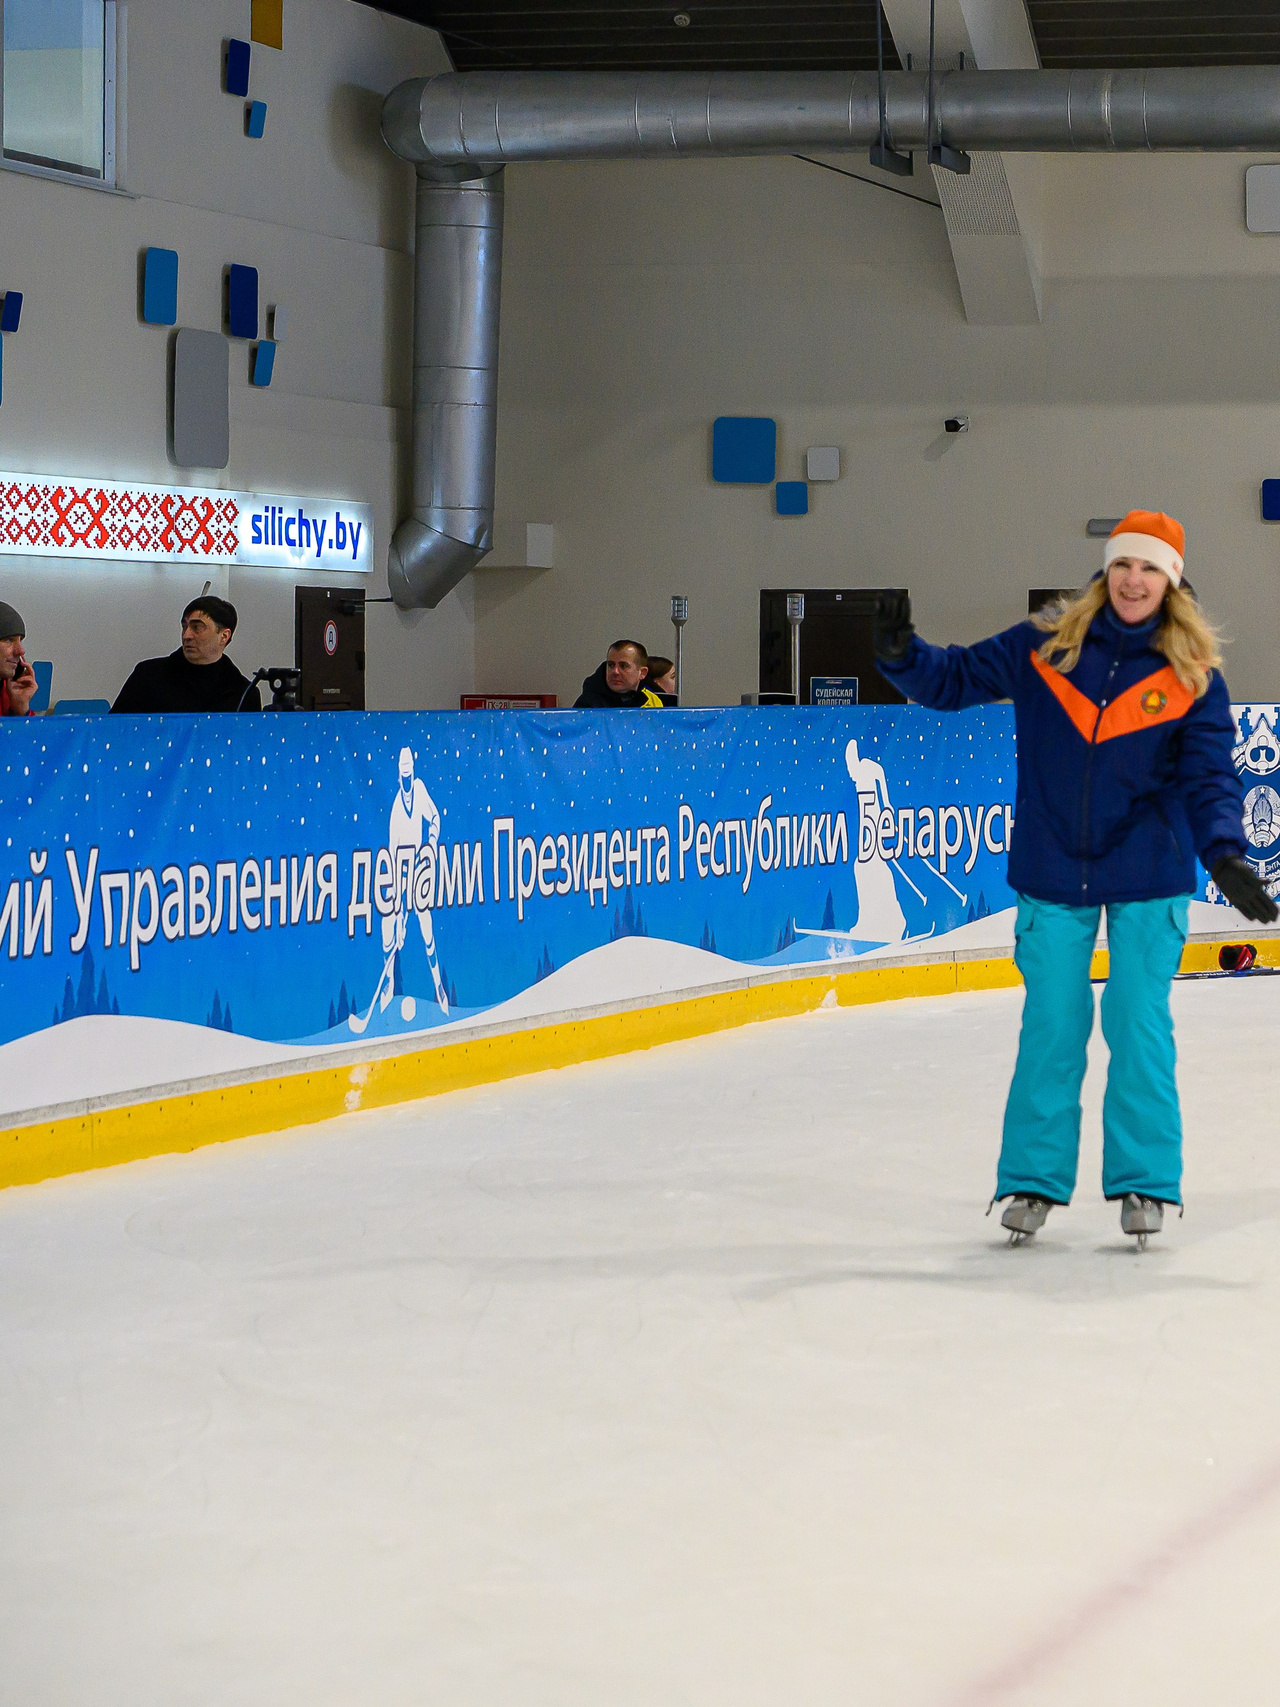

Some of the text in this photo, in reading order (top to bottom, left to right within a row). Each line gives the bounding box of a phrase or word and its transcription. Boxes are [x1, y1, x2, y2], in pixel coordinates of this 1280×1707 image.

[251, 505, 362, 560] silichy.by
[815, 687, 853, 698] СУДЕЙСКАЯ
[65, 847, 338, 971] Управления
[348, 843, 485, 936] делами
[493, 817, 671, 921] Президента
[678, 794, 849, 894] Республики
